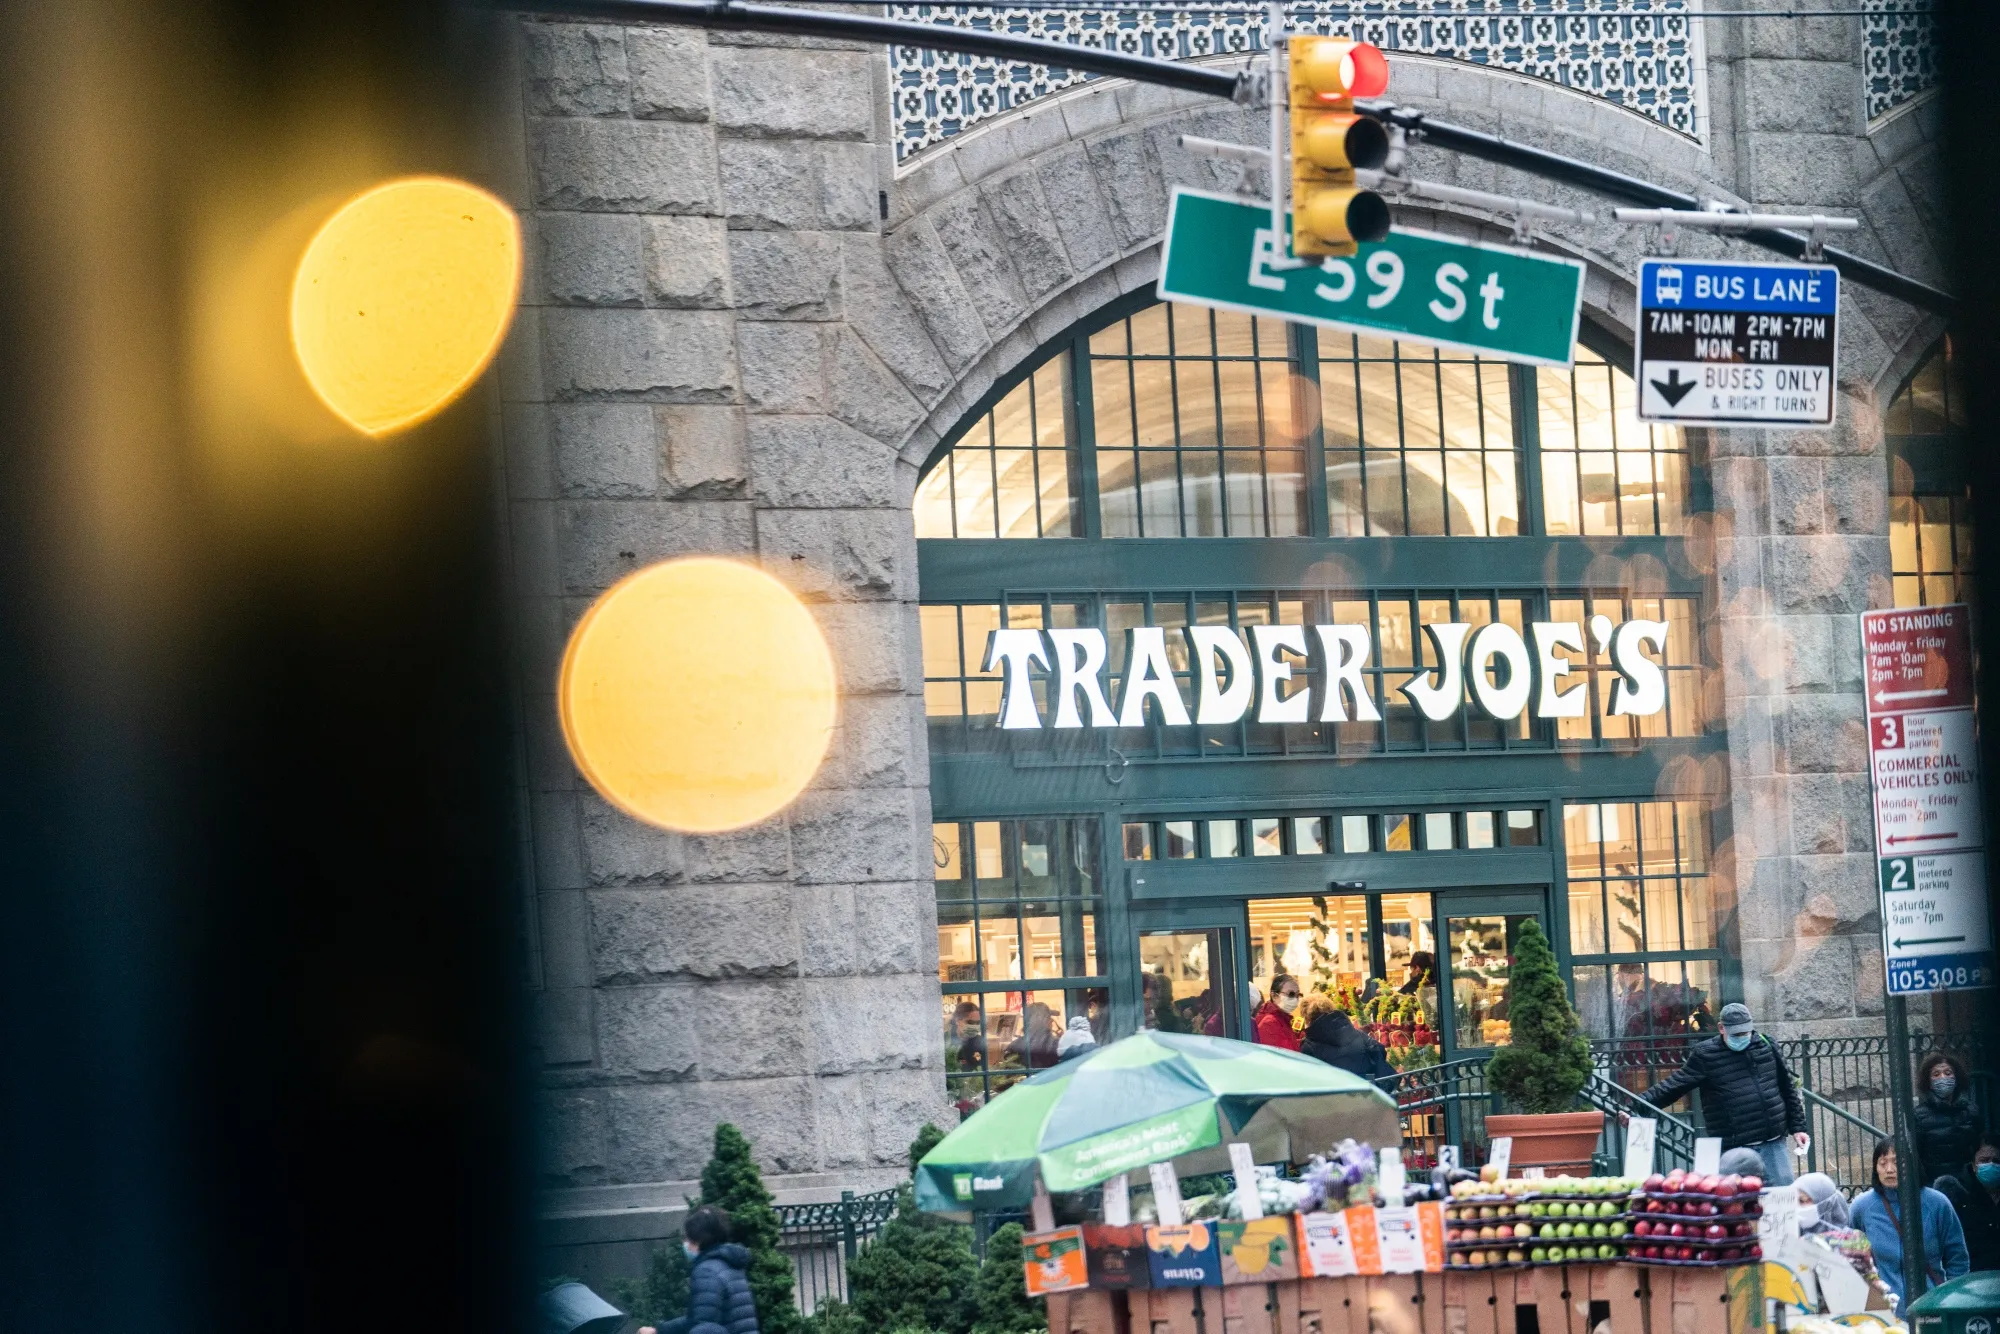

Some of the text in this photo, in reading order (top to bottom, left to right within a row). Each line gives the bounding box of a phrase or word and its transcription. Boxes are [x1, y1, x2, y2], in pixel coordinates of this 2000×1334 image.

[1248, 227, 1504, 330] E 59 St
[1695, 275, 1821, 303] BUS LANE
[1706, 367, 1823, 391] BUSES ONLY
[1728, 396, 1766, 411] RIGHT
[1775, 397, 1817, 413] TURNS
[1868, 614, 1953, 634] NO STANDING
[1870, 641, 1907, 654] Monday
[1916, 636, 1946, 650] Friday
[1871, 655, 1892, 667] 7am
[1901, 652, 1926, 664] 10am
[983, 614, 1670, 728] TRADER JOE'S
[1872, 669, 1893, 683] 2pm
[1902, 667, 1923, 680] 7pm
[1907, 717, 1926, 726] hour
[1880, 717, 1898, 748] 3
[1908, 726, 1943, 737] metered
[1909, 736, 1939, 750] parking
[1878, 755, 1961, 773] COMMERCIAL
[1880, 770, 1975, 790] VEHICLES ONLY
[1881, 797, 1918, 810] Monday
[1928, 795, 1958, 807] Friday
[1883, 812, 1907, 824] 10am
[1917, 810, 1938, 823] 2pm
[1918, 857, 1935, 867] hour
[1890, 859, 1908, 889] 2
[1918, 867, 1953, 879] metered
[1919, 879, 1949, 891] parking
[1892, 899, 1936, 912] Saturday
[1892, 914, 1914, 925] 9am
[1923, 911, 1944, 924] 7pm
[1891, 967, 1968, 990] 105308
[1163, 1267, 1205, 1281] Citrus
